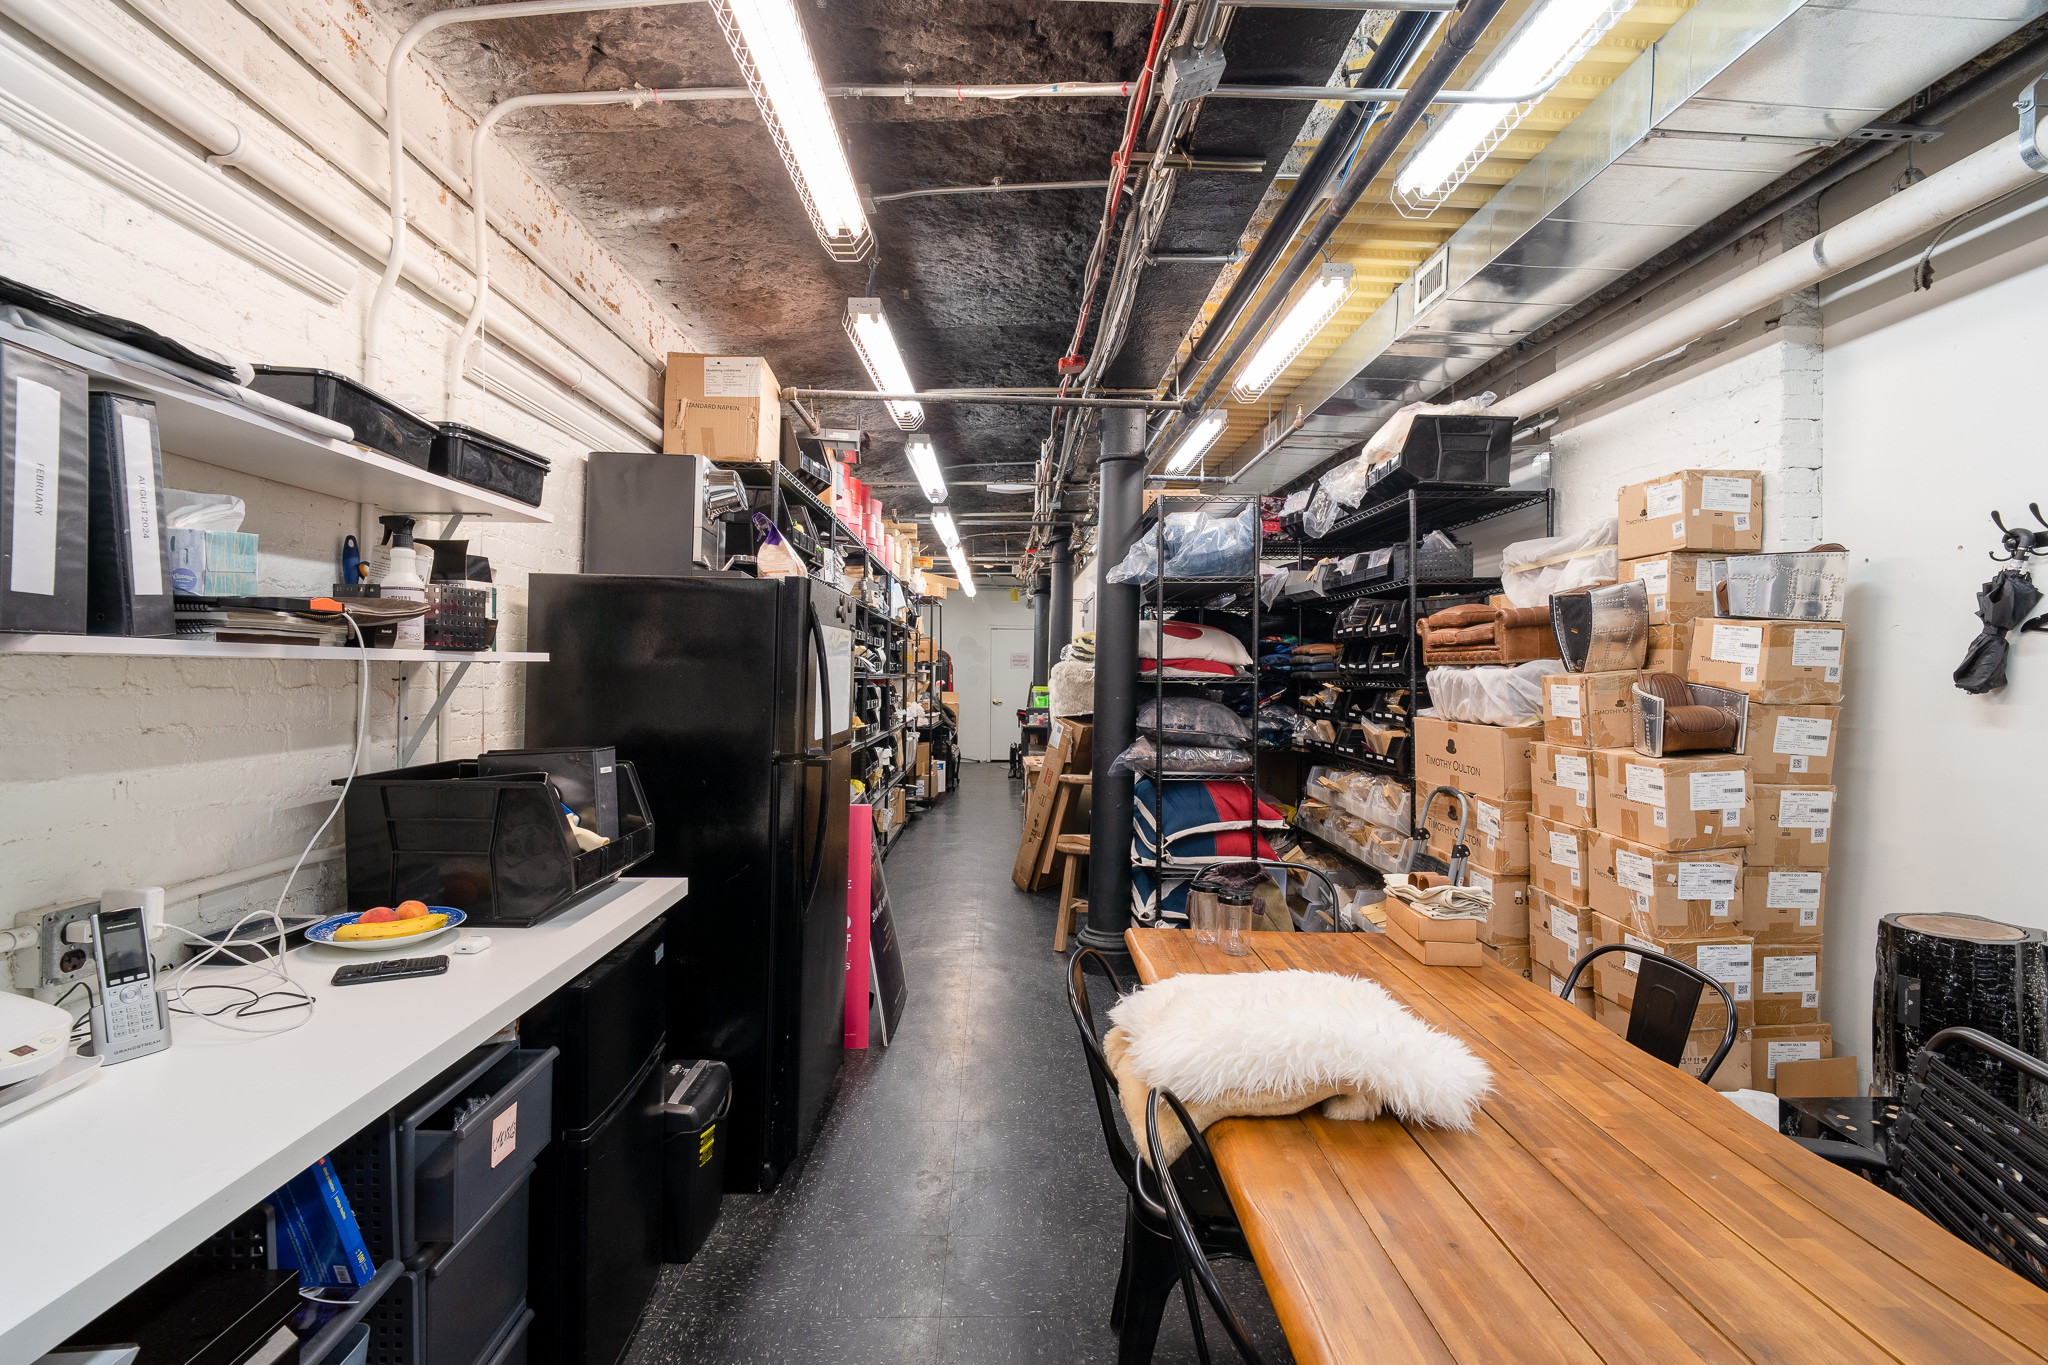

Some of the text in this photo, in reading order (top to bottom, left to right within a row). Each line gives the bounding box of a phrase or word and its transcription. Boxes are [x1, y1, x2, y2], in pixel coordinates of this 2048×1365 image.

[686, 402, 717, 410] STANDARD
[35, 463, 45, 517] FEBRUARY
[138, 475, 150, 539] AUGUST 2024
[1425, 754, 1481, 777] TIMOTHY OULTON
[1427, 816, 1454, 836] TIMOTHY
[107, 922, 137, 930] GRANDSTREAM
[113, 1039, 162, 1055] GRANDSTREAM
